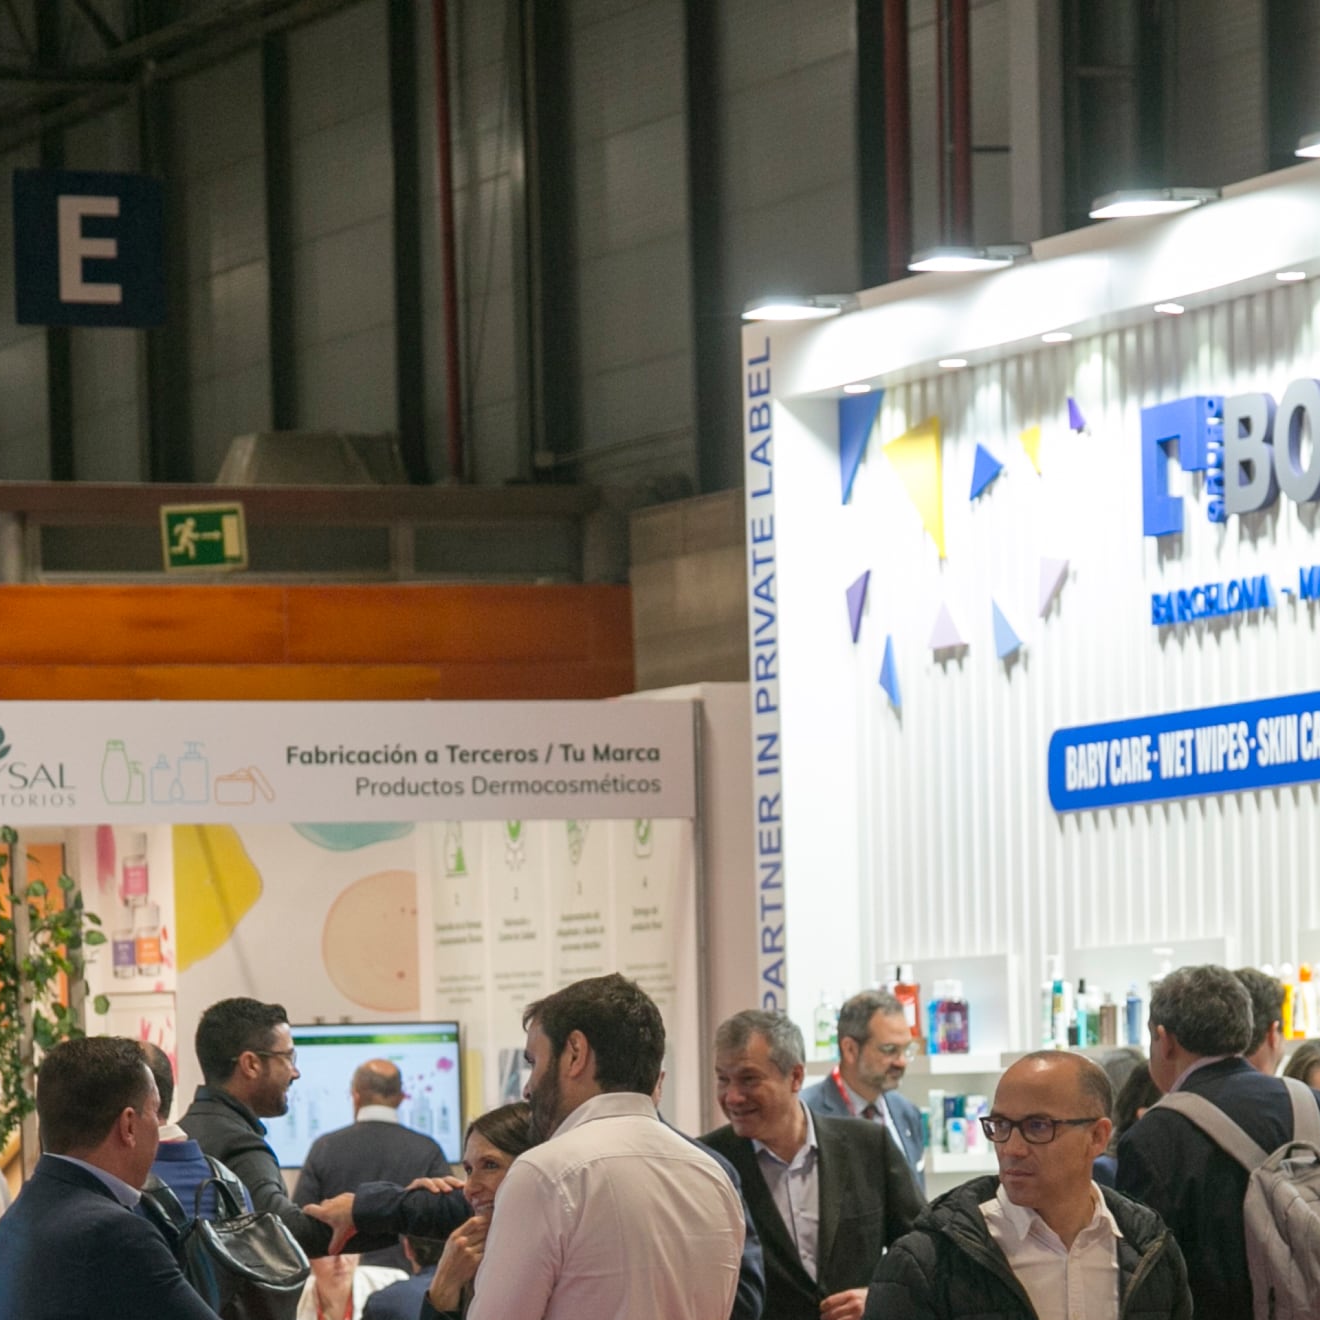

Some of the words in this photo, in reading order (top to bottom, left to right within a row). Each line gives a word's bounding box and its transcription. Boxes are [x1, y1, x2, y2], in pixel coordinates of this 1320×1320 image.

[57, 195, 123, 305] E
[747, 336, 774, 498] LABEL
[751, 514, 778, 714] PRIVATE
[1151, 574, 1272, 627] BARCELONA
[286, 743, 417, 765] Fabricación
[424, 749, 439, 764] a
[445, 744, 538, 763] Terceros
[544, 744, 553, 764] /
[559, 743, 585, 762] Tu
[592, 743, 661, 763] Marca
[355, 776, 465, 796] Productos
[471, 774, 662, 796] Dermocosméticos
[756, 732, 779, 776] IN
[1065, 740, 1110, 791] BABY
[1109, 735, 1152, 786] CARE
[1158, 729, 1194, 780] WET
[1194, 721, 1249, 775] WIPES
[1256, 714, 1298, 768] SKIN
